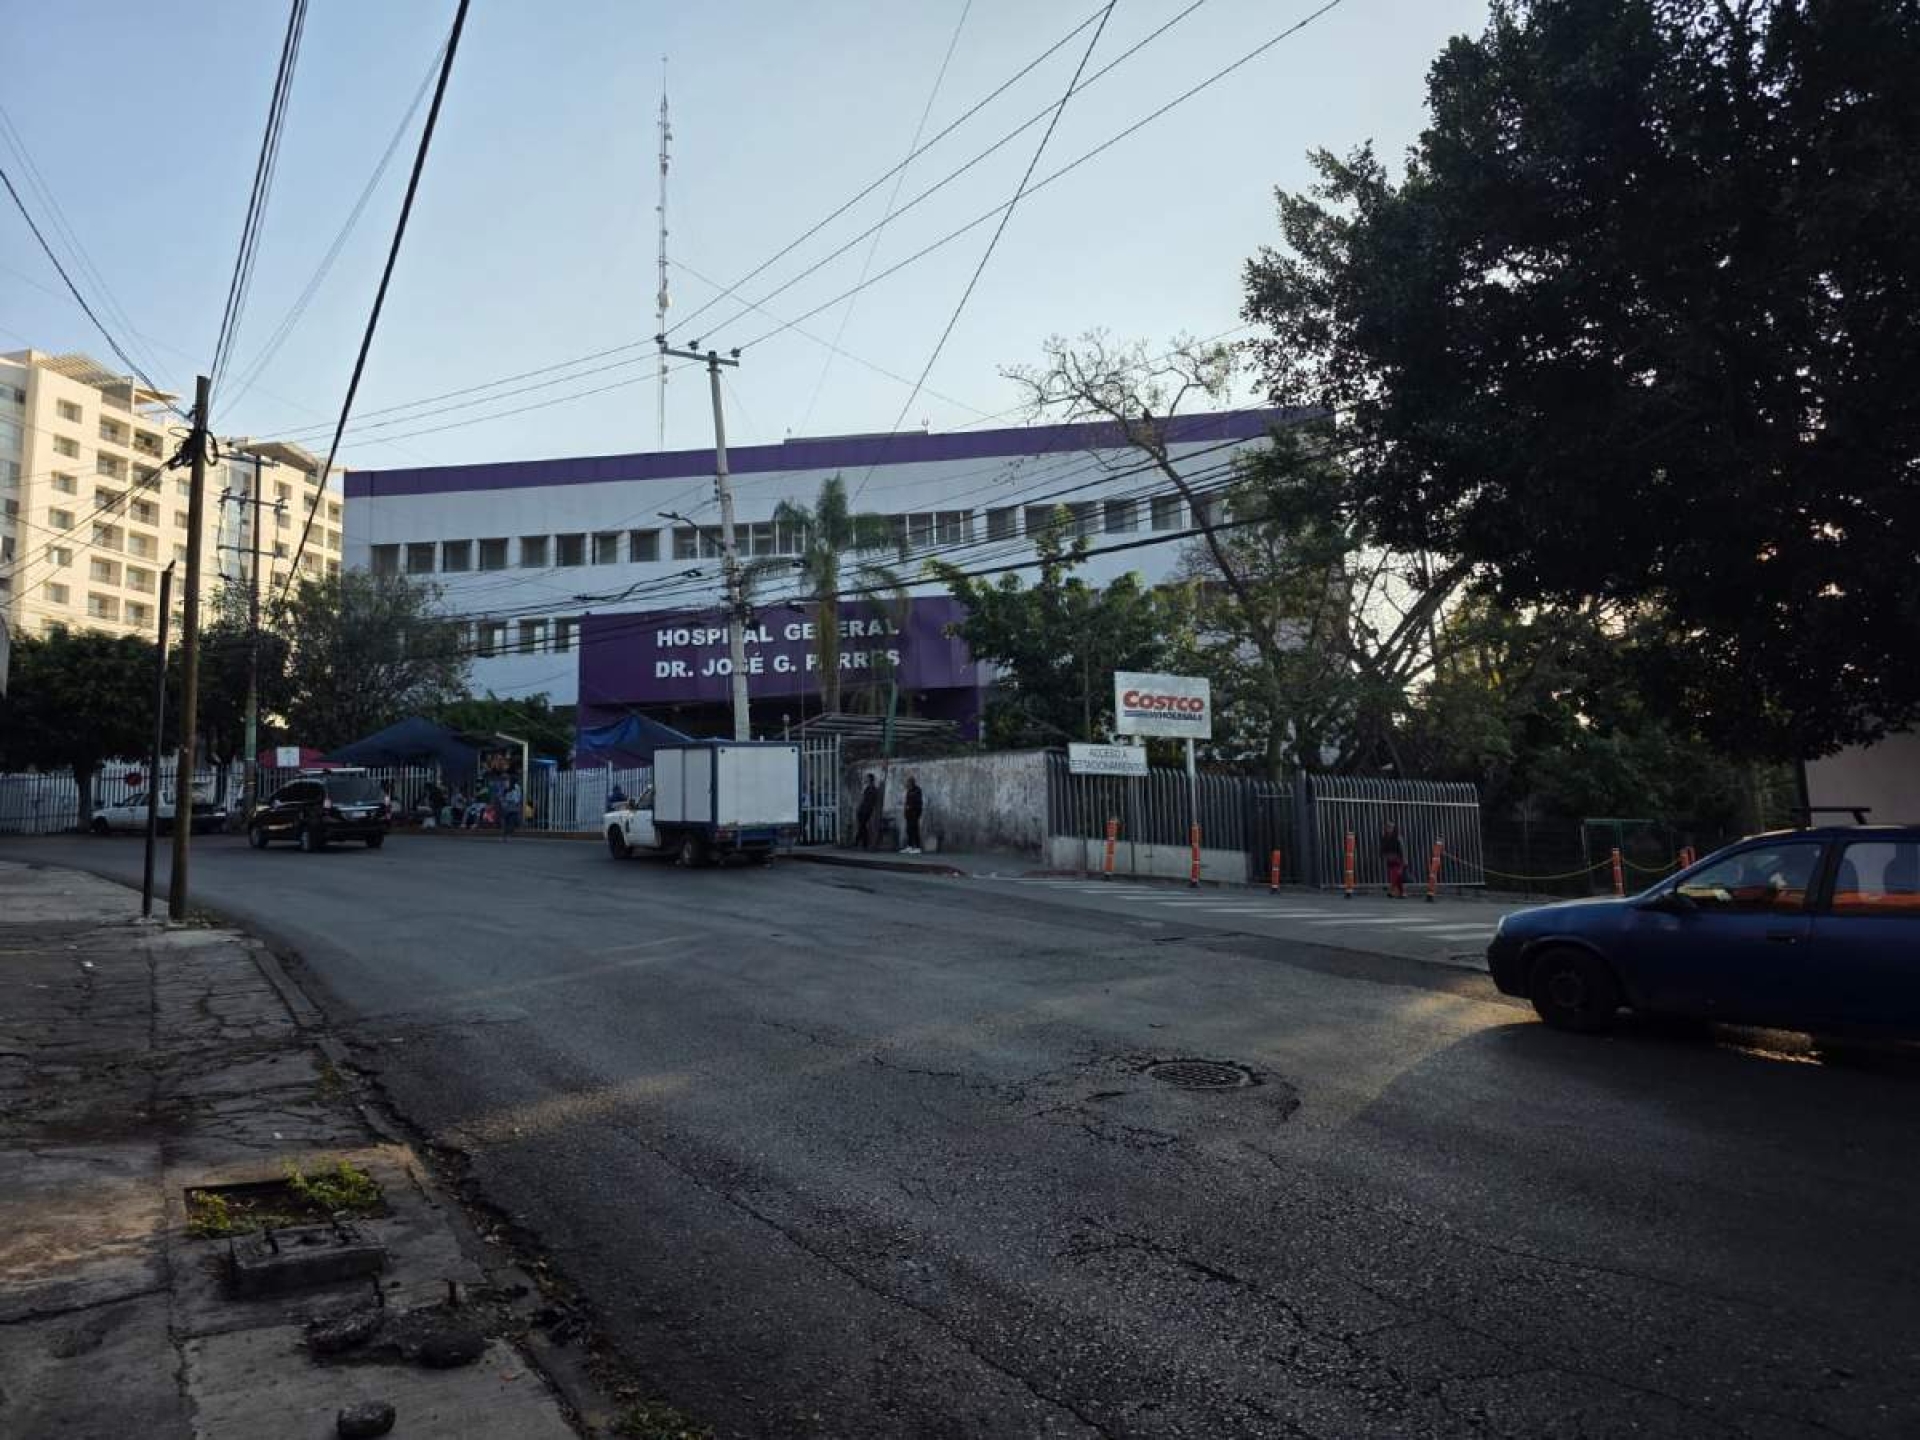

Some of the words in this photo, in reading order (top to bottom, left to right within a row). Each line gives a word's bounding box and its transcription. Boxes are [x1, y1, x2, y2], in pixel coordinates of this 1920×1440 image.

[656, 624, 774, 647] HOSPIAL
[784, 618, 900, 641] GEERAL
[655, 660, 694, 678] DR.
[773, 655, 797, 672] G.
[805, 649, 901, 671] PRRS
